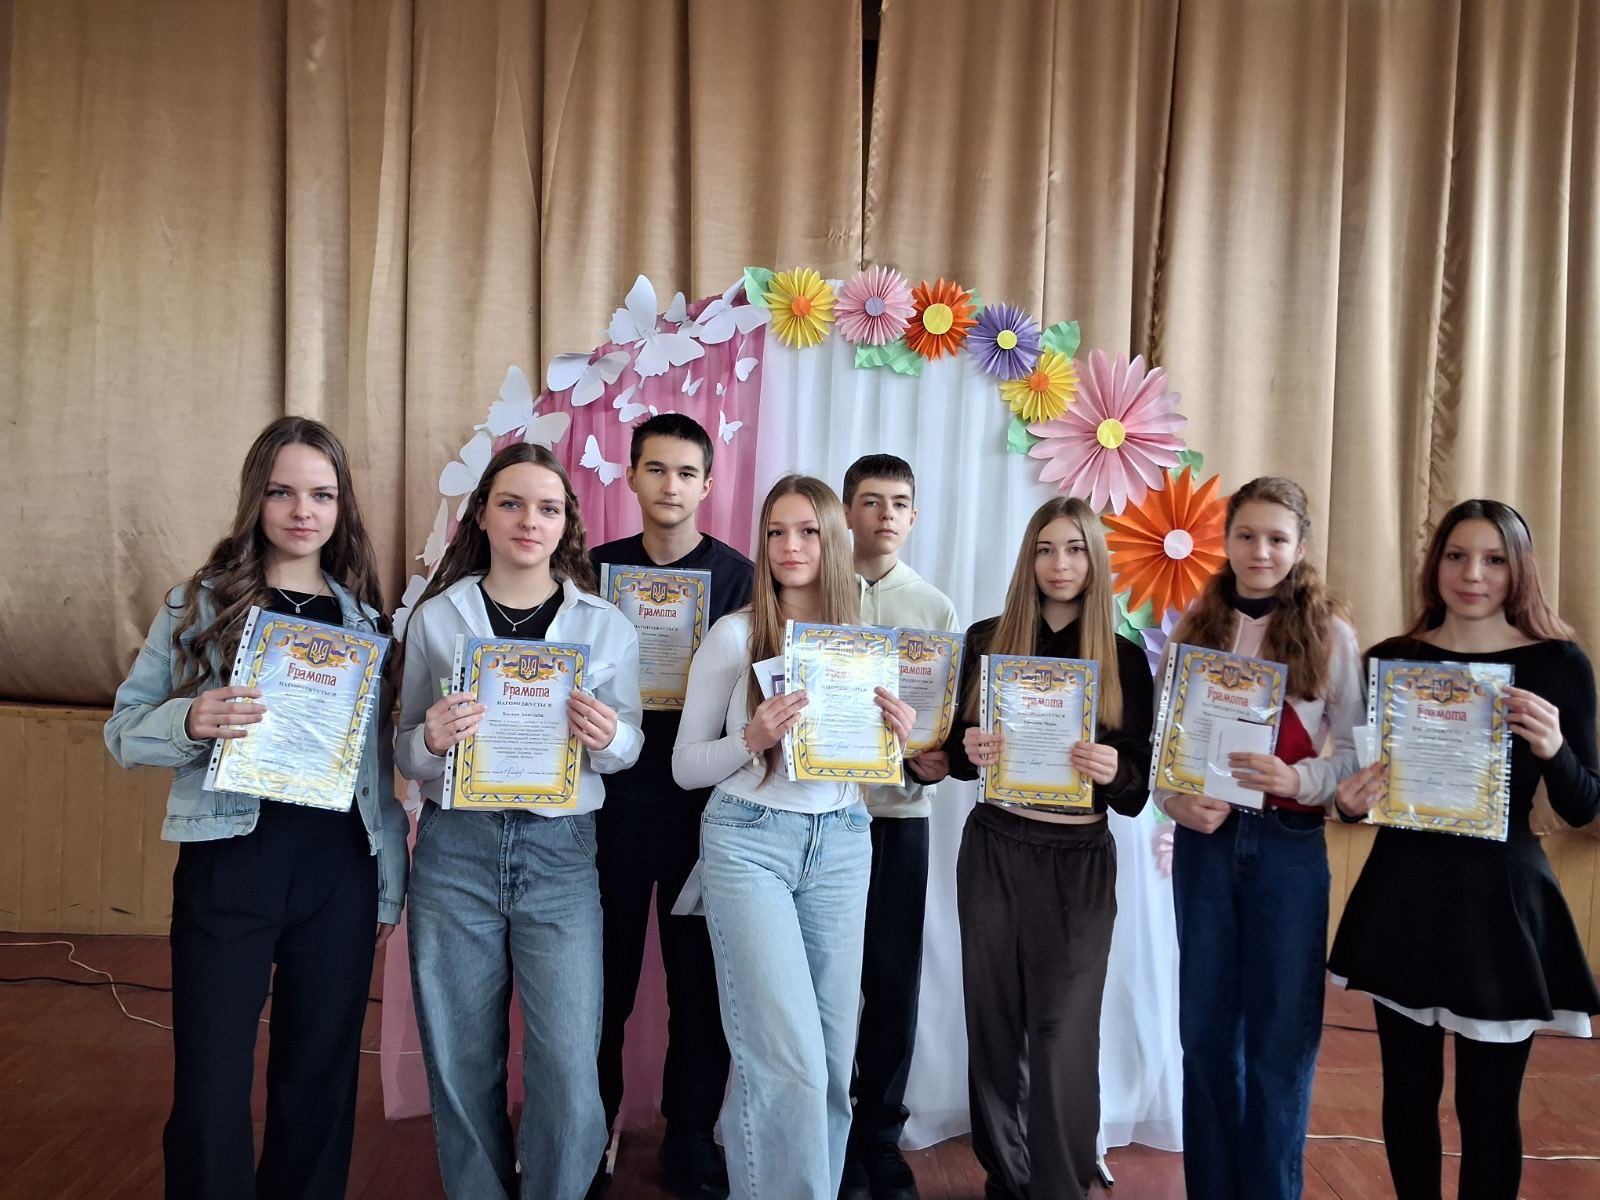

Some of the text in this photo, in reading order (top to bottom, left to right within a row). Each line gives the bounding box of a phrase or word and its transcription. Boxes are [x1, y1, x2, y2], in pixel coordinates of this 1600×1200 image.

[638, 604, 677, 619] Грамота
[287, 662, 337, 687] Грамота
[899, 664, 932, 677] рамота
[279, 681, 337, 697] НАГЖУЄТЬСЯ
[503, 681, 550, 700] Грамота
[1207, 686, 1248, 707] Грамота
